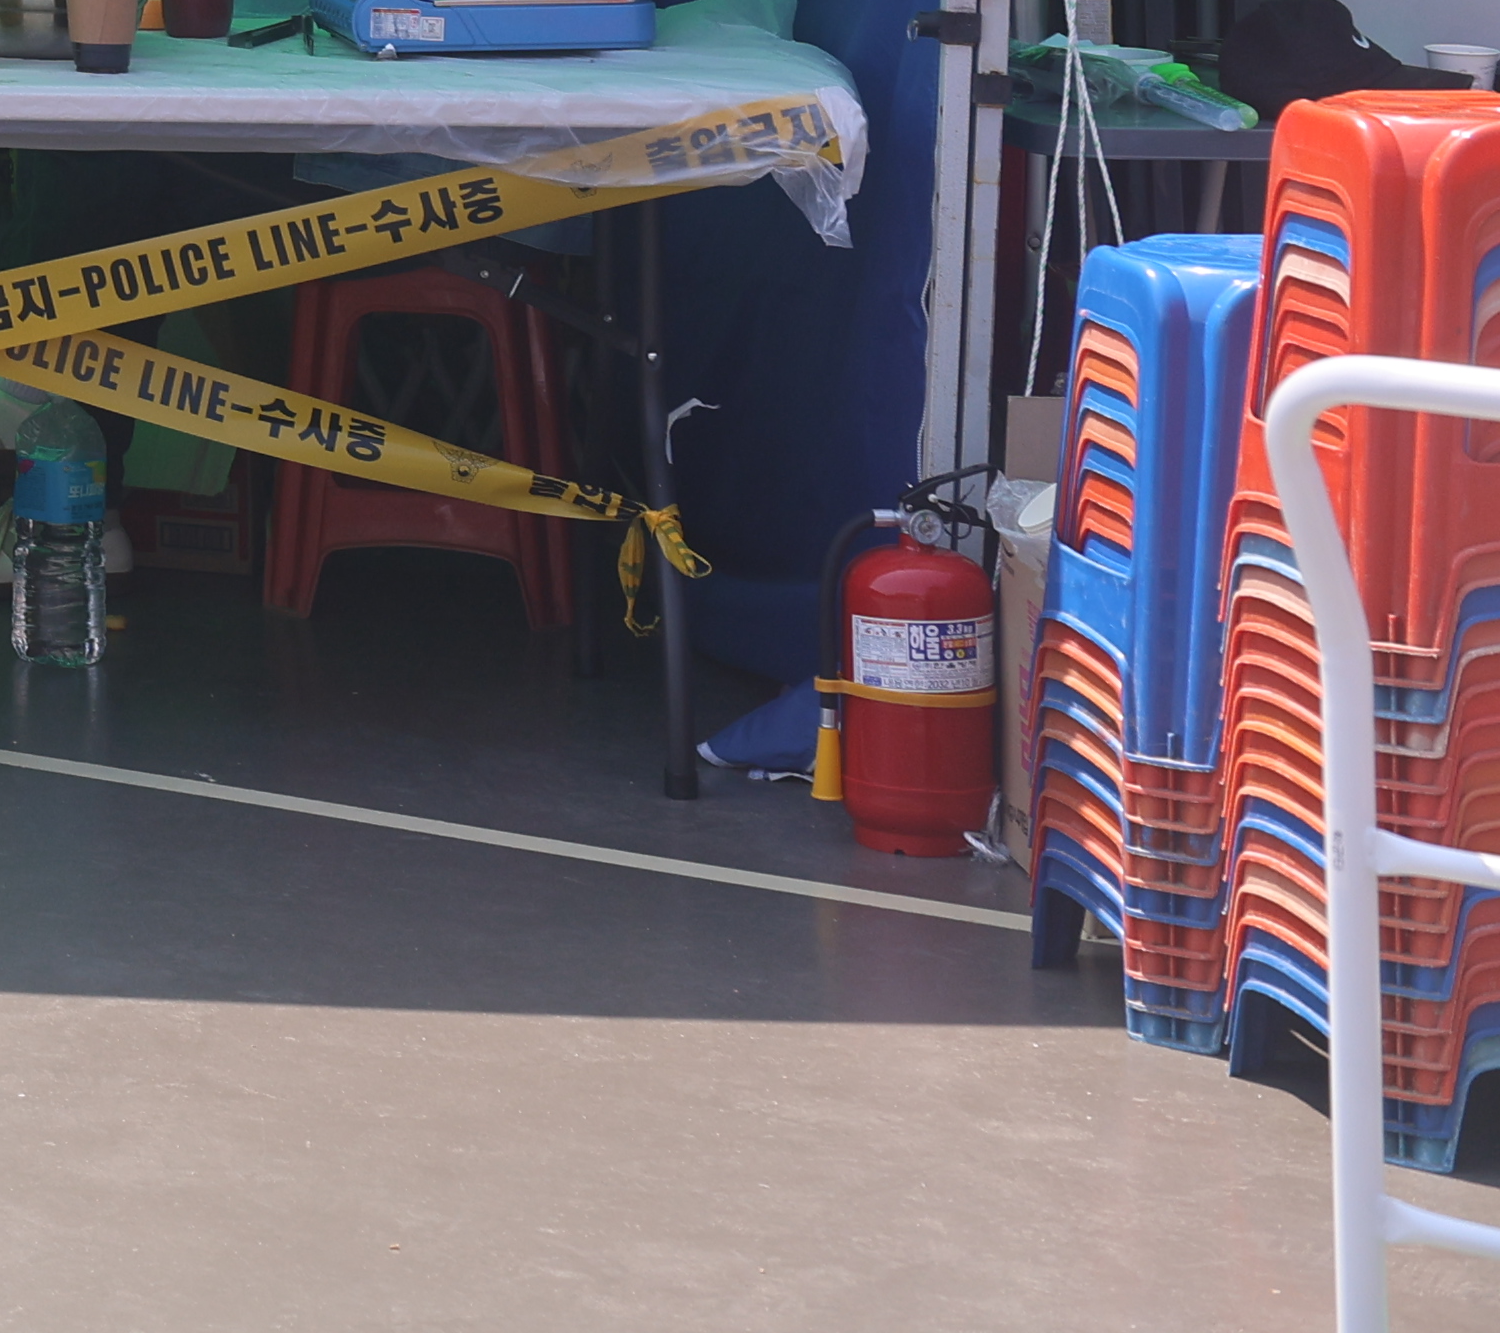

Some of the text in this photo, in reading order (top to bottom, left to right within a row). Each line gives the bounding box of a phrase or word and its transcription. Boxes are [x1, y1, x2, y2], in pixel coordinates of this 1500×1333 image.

[252, 174, 506, 270] LINE-수사중
[136, 356, 390, 462] LINE-수사중
[909, 625, 941, 660] 한울
